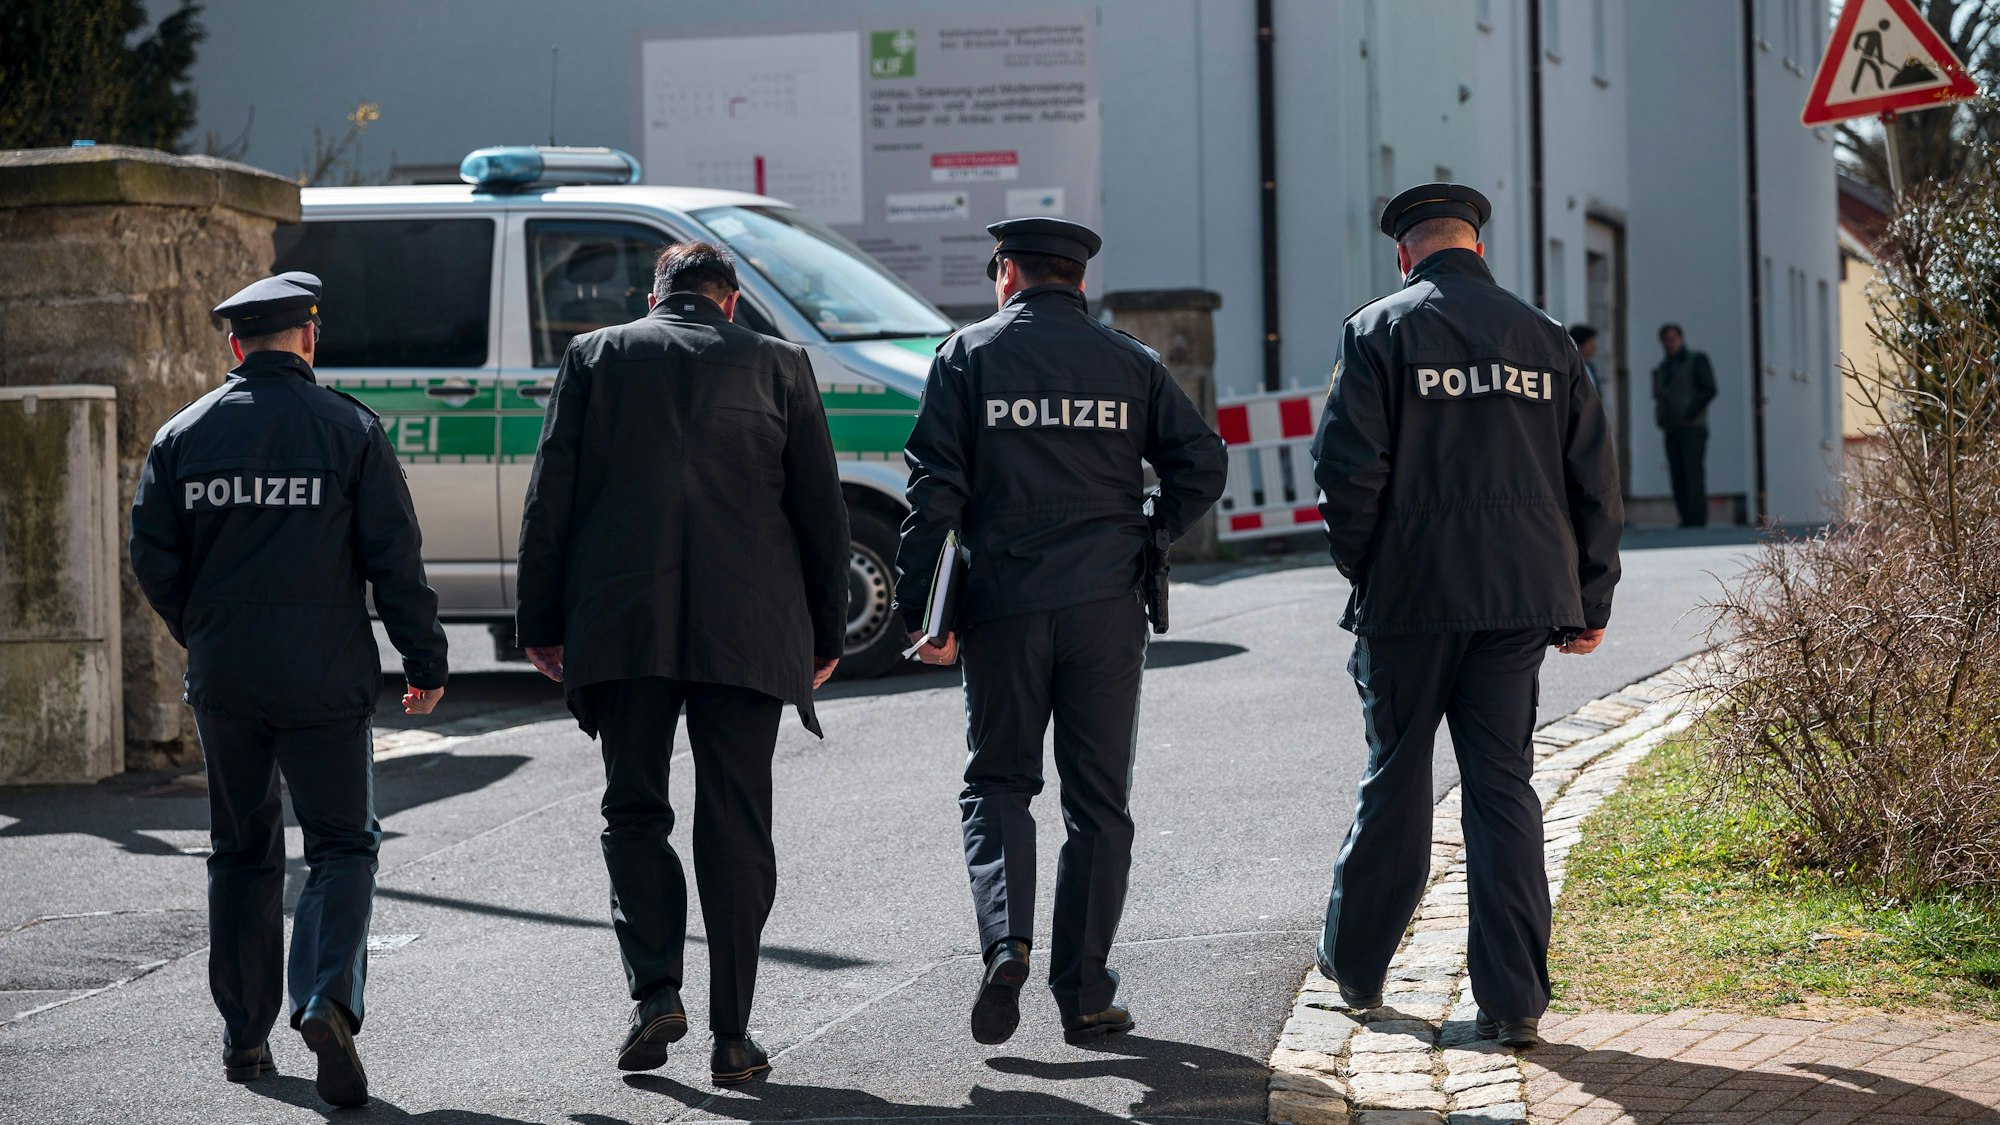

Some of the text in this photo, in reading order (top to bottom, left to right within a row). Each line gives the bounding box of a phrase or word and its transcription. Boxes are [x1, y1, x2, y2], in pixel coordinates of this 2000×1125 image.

[1417, 364, 1552, 399] POLIZEI
[986, 398, 1128, 430] POLIZEI
[184, 476, 321, 510] POLIZEI
